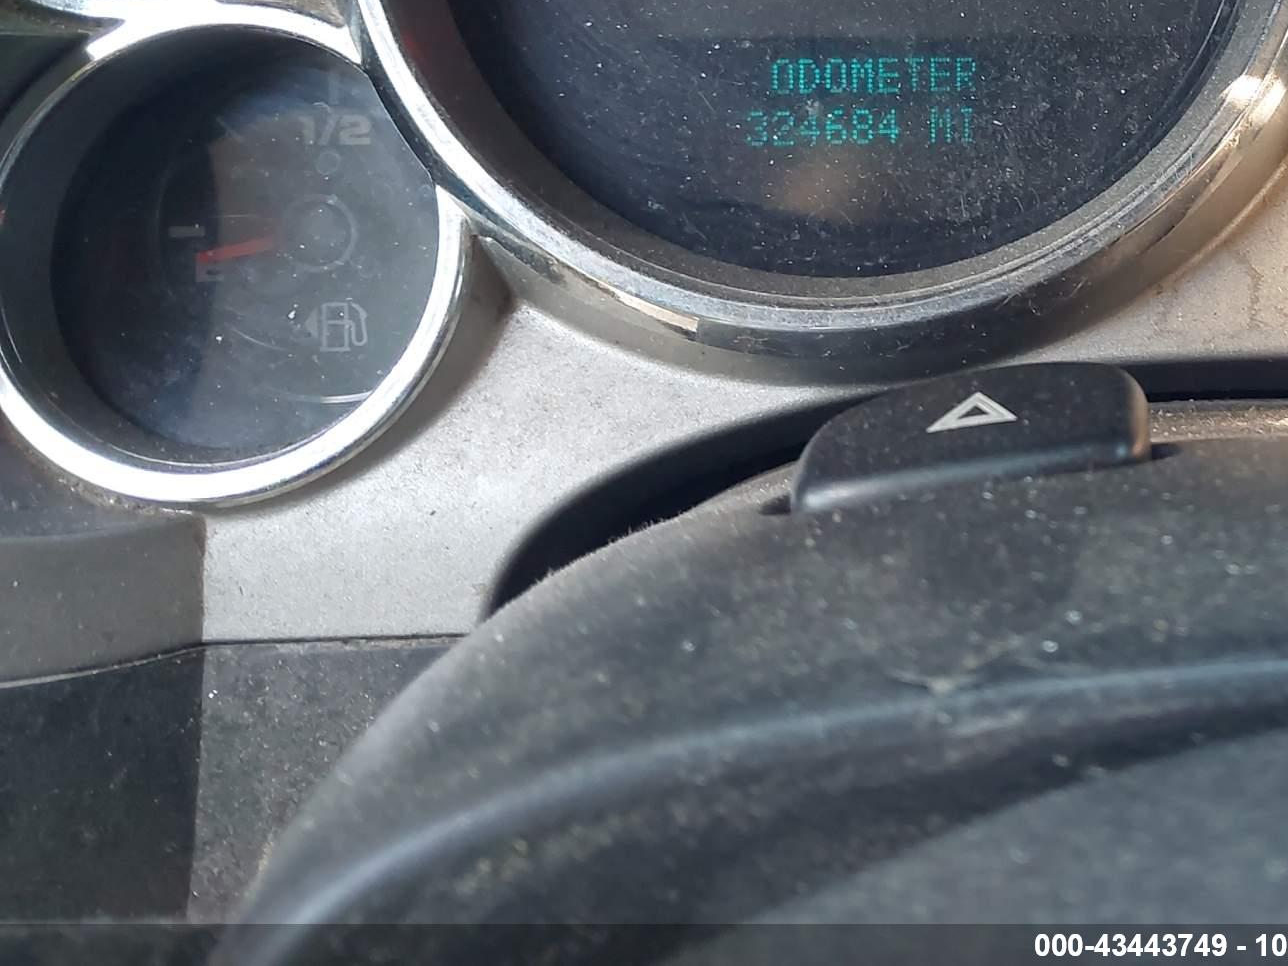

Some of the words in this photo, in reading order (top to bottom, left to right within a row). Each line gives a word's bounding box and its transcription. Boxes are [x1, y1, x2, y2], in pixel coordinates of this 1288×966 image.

[770, 59, 975, 95] ODOMETER
[298, 113, 372, 146] 1/2
[744, 111, 900, 146] 324684
[929, 110, 976, 144] MI
